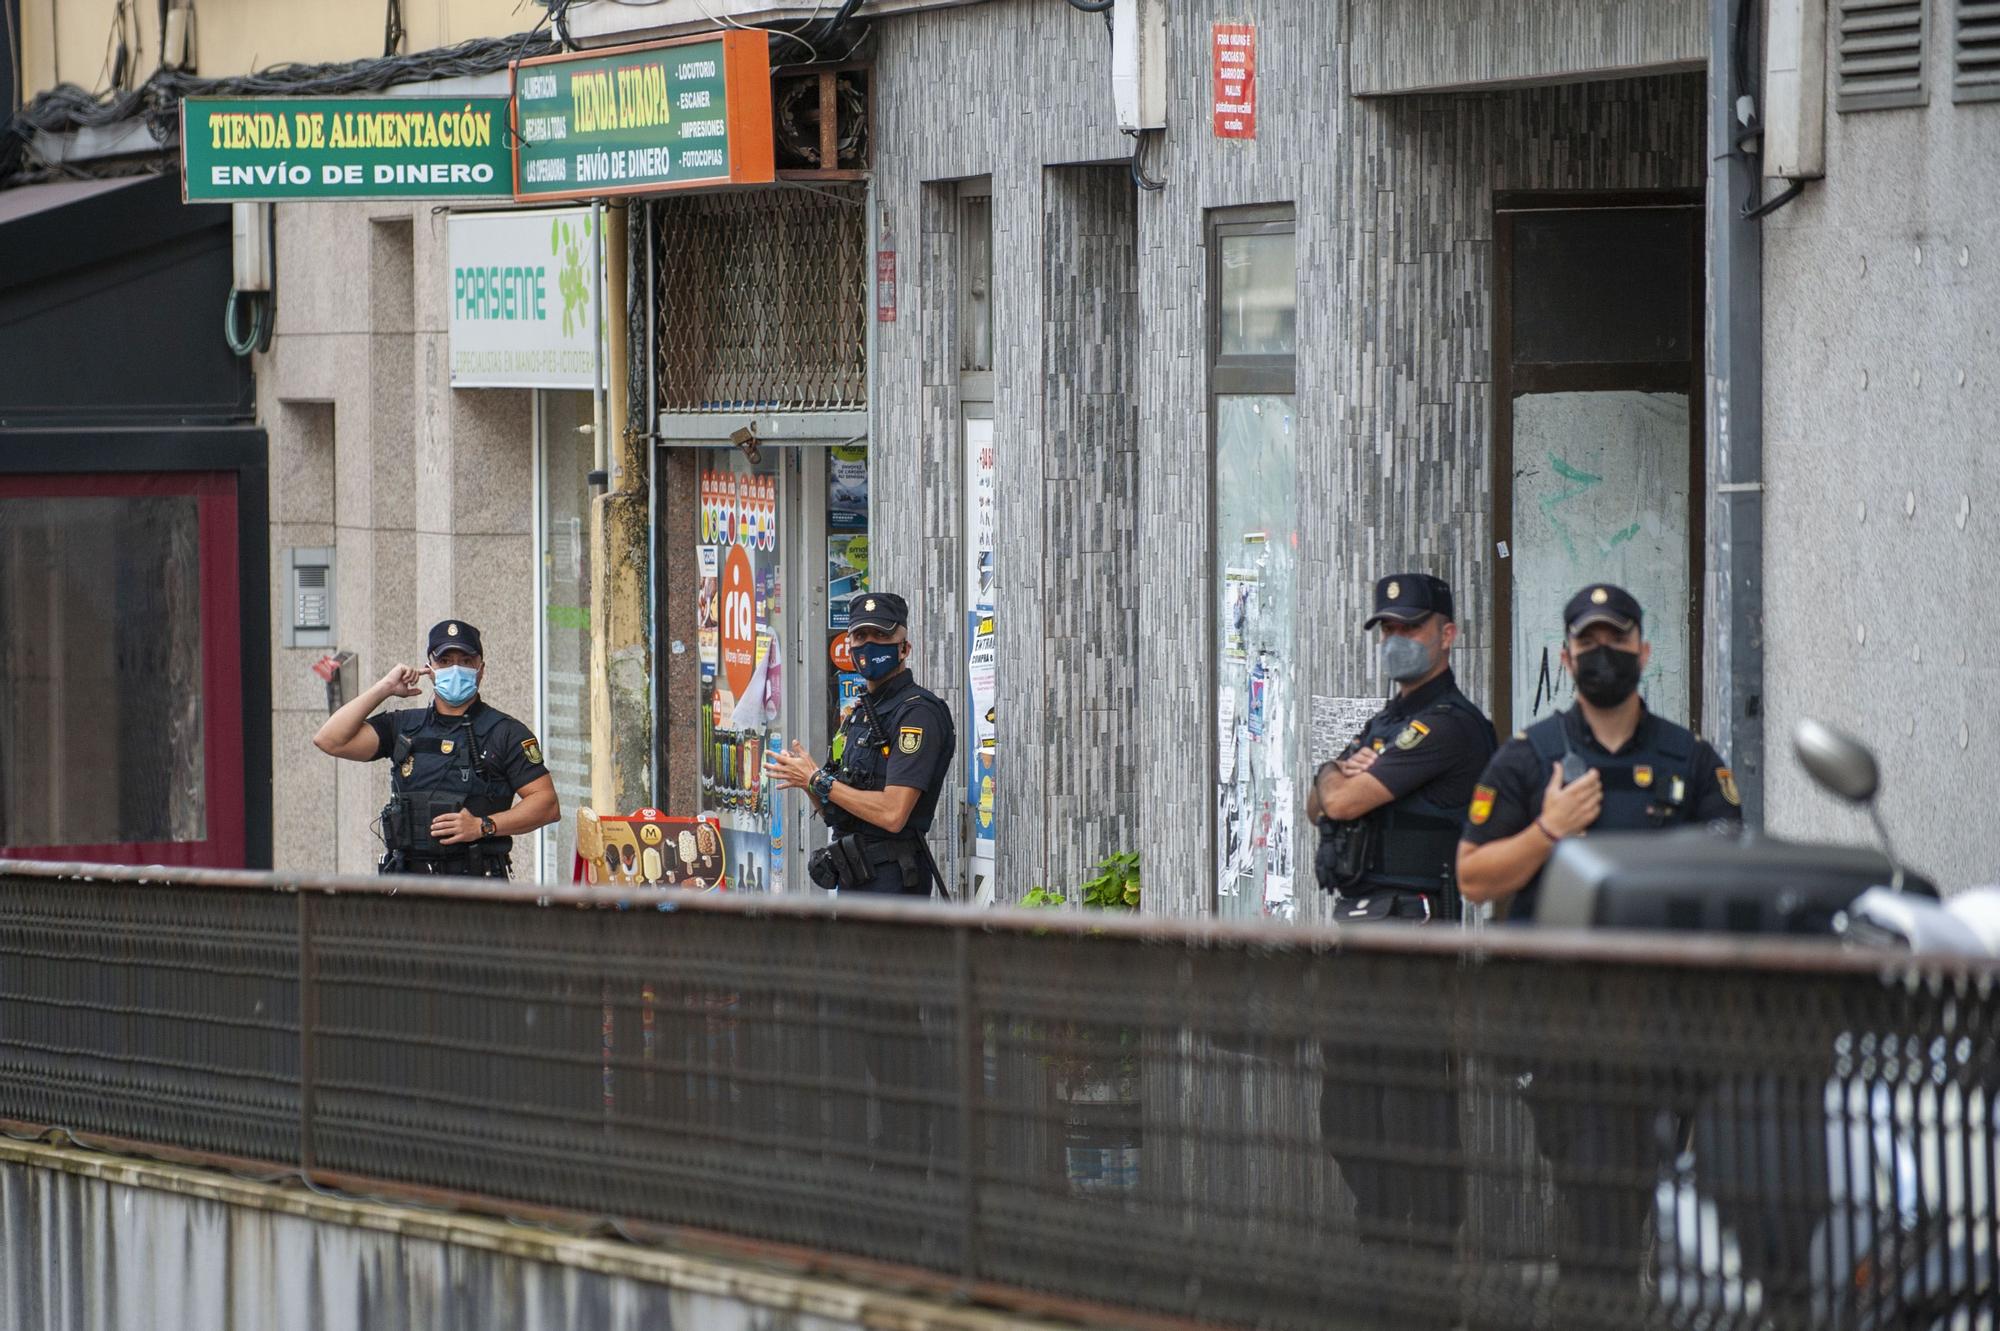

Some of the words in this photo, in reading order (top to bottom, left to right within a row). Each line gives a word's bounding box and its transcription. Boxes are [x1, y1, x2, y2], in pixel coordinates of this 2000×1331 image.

[678, 61, 716, 80] LOCUTORIO
[524, 70, 557, 100] ALIMENTACIÓN
[571, 71, 617, 133] TIENDA
[617, 64, 669, 128] EUROPA
[680, 91, 711, 110] ESCANER
[209, 112, 291, 149] TIENDA
[295, 113, 325, 149] DE
[329, 102, 491, 148] ALIMENTACIÓN
[550, 116, 567, 139] TODAS
[681, 119, 724, 139] IMPRESIONES
[576, 146, 609, 182] ENVÍO
[611, 151, 626, 178] DE
[628, 146, 670, 176] DINERO
[682, 149, 723, 168] FOTOCOPIAS
[211, 161, 312, 185] ENVÍO
[322, 165, 363, 184] DE
[374, 163, 493, 184] DINERO
[455, 266, 546, 321] PARISIENNE
[725, 564, 752, 642] ria
